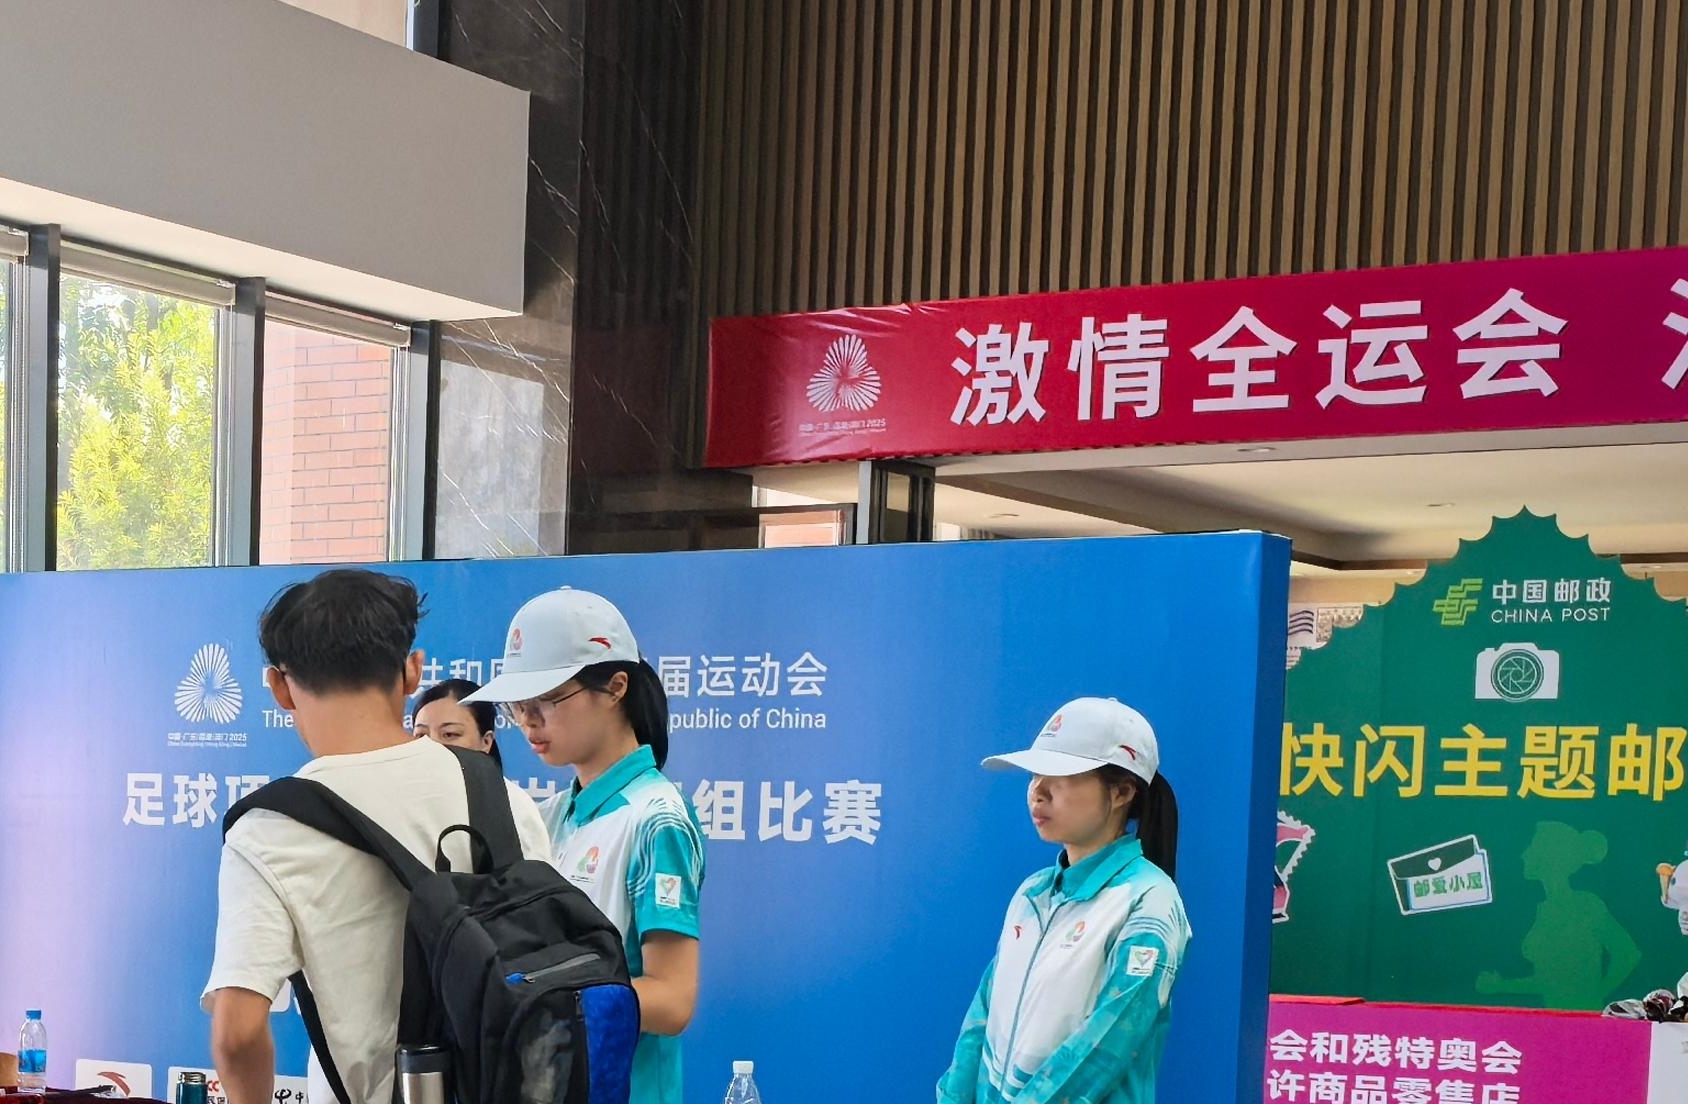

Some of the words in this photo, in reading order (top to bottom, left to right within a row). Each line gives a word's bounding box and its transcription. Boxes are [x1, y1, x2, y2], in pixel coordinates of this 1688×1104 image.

[949, 287, 1569, 427] 激情全运会
[1492, 577, 1612, 605] 中国邮政
[1491, 609, 1553, 623] CHINA
[1561, 607, 1611, 622] POST
[263, 710, 294, 728] The
[669, 707, 732, 733] public
[738, 708, 761, 729] of
[766, 707, 827, 729] China
[1279, 722, 1688, 801] 快闪主题邮
[1269, 1028, 1523, 1075] 会和残特奥会
